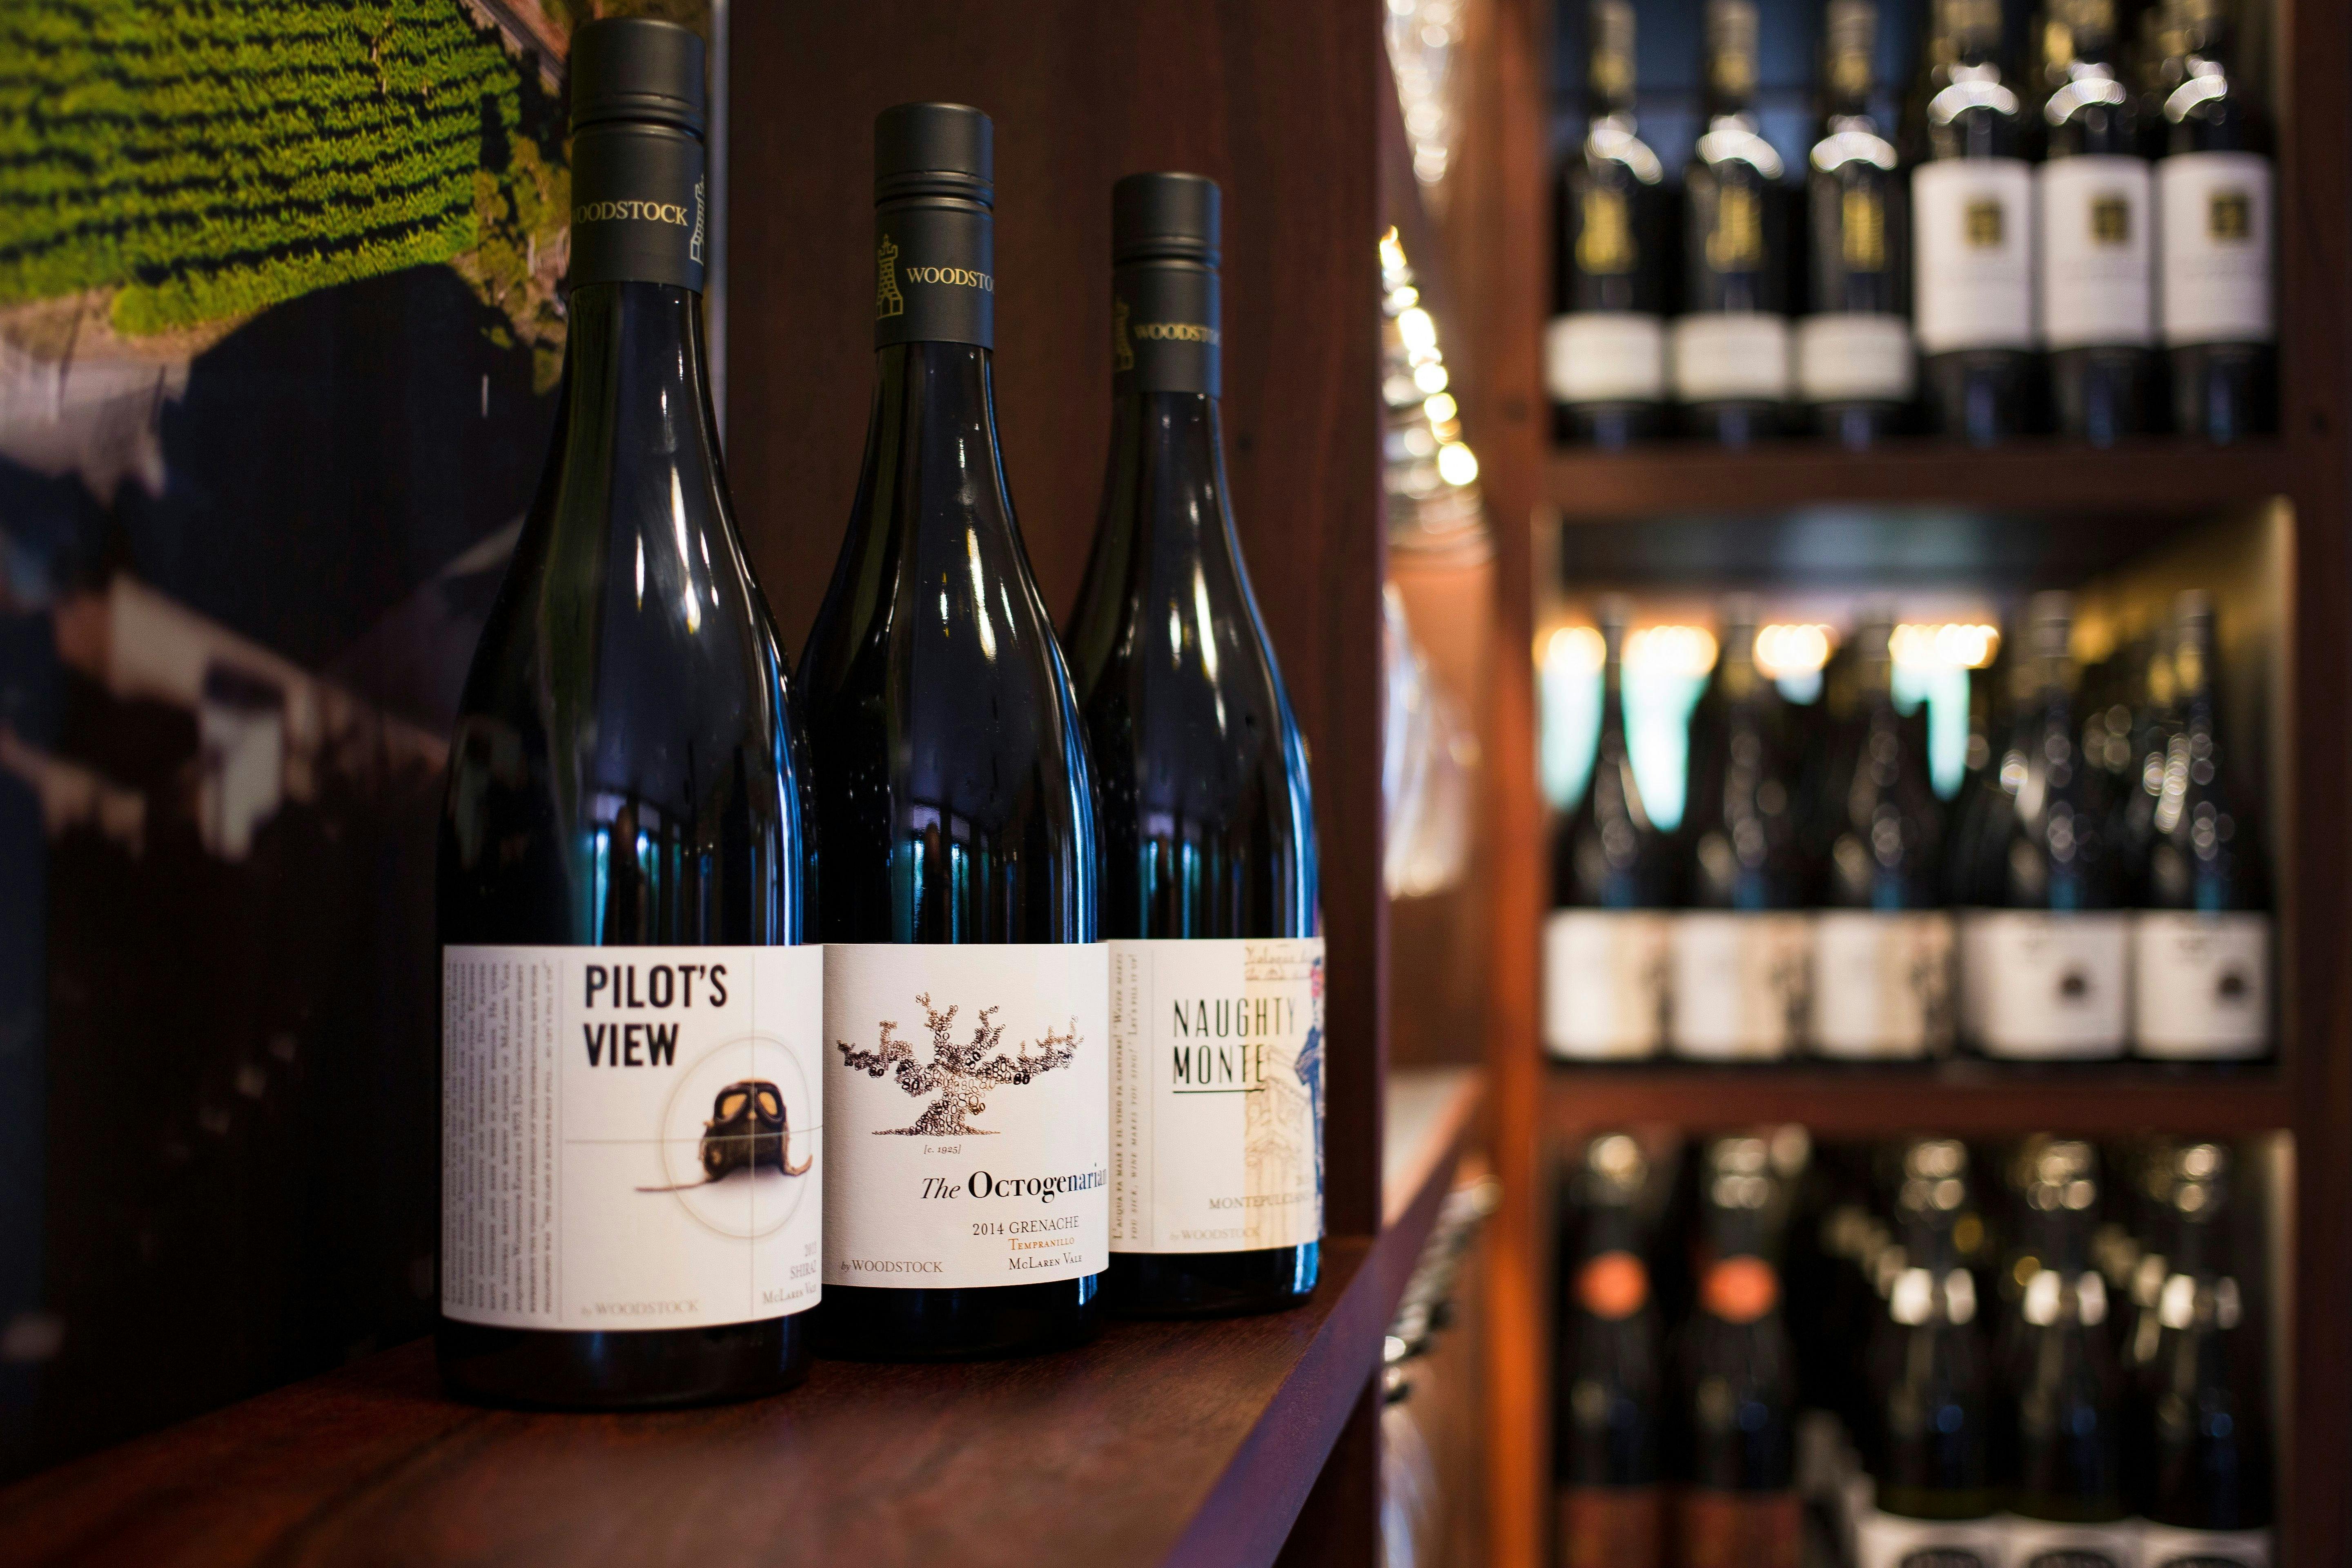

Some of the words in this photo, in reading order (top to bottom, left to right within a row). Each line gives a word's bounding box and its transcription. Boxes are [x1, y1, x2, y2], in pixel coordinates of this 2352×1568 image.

[906, 267, 994, 292] WOODSTO
[584, 964, 728, 1009] PILOT'S
[1173, 997, 1296, 1037] NAUGHTY
[583, 1022, 680, 1067] VIEW
[1173, 1044, 1265, 1084] MONTE
[938, 1145, 961, 1154] 1925]
[920, 1178, 961, 1199] The
[973, 1223, 1004, 1235] 2014
[1009, 1216, 1079, 1234] GRENACHE
[851, 1260, 944, 1272] WOODSTOCK
